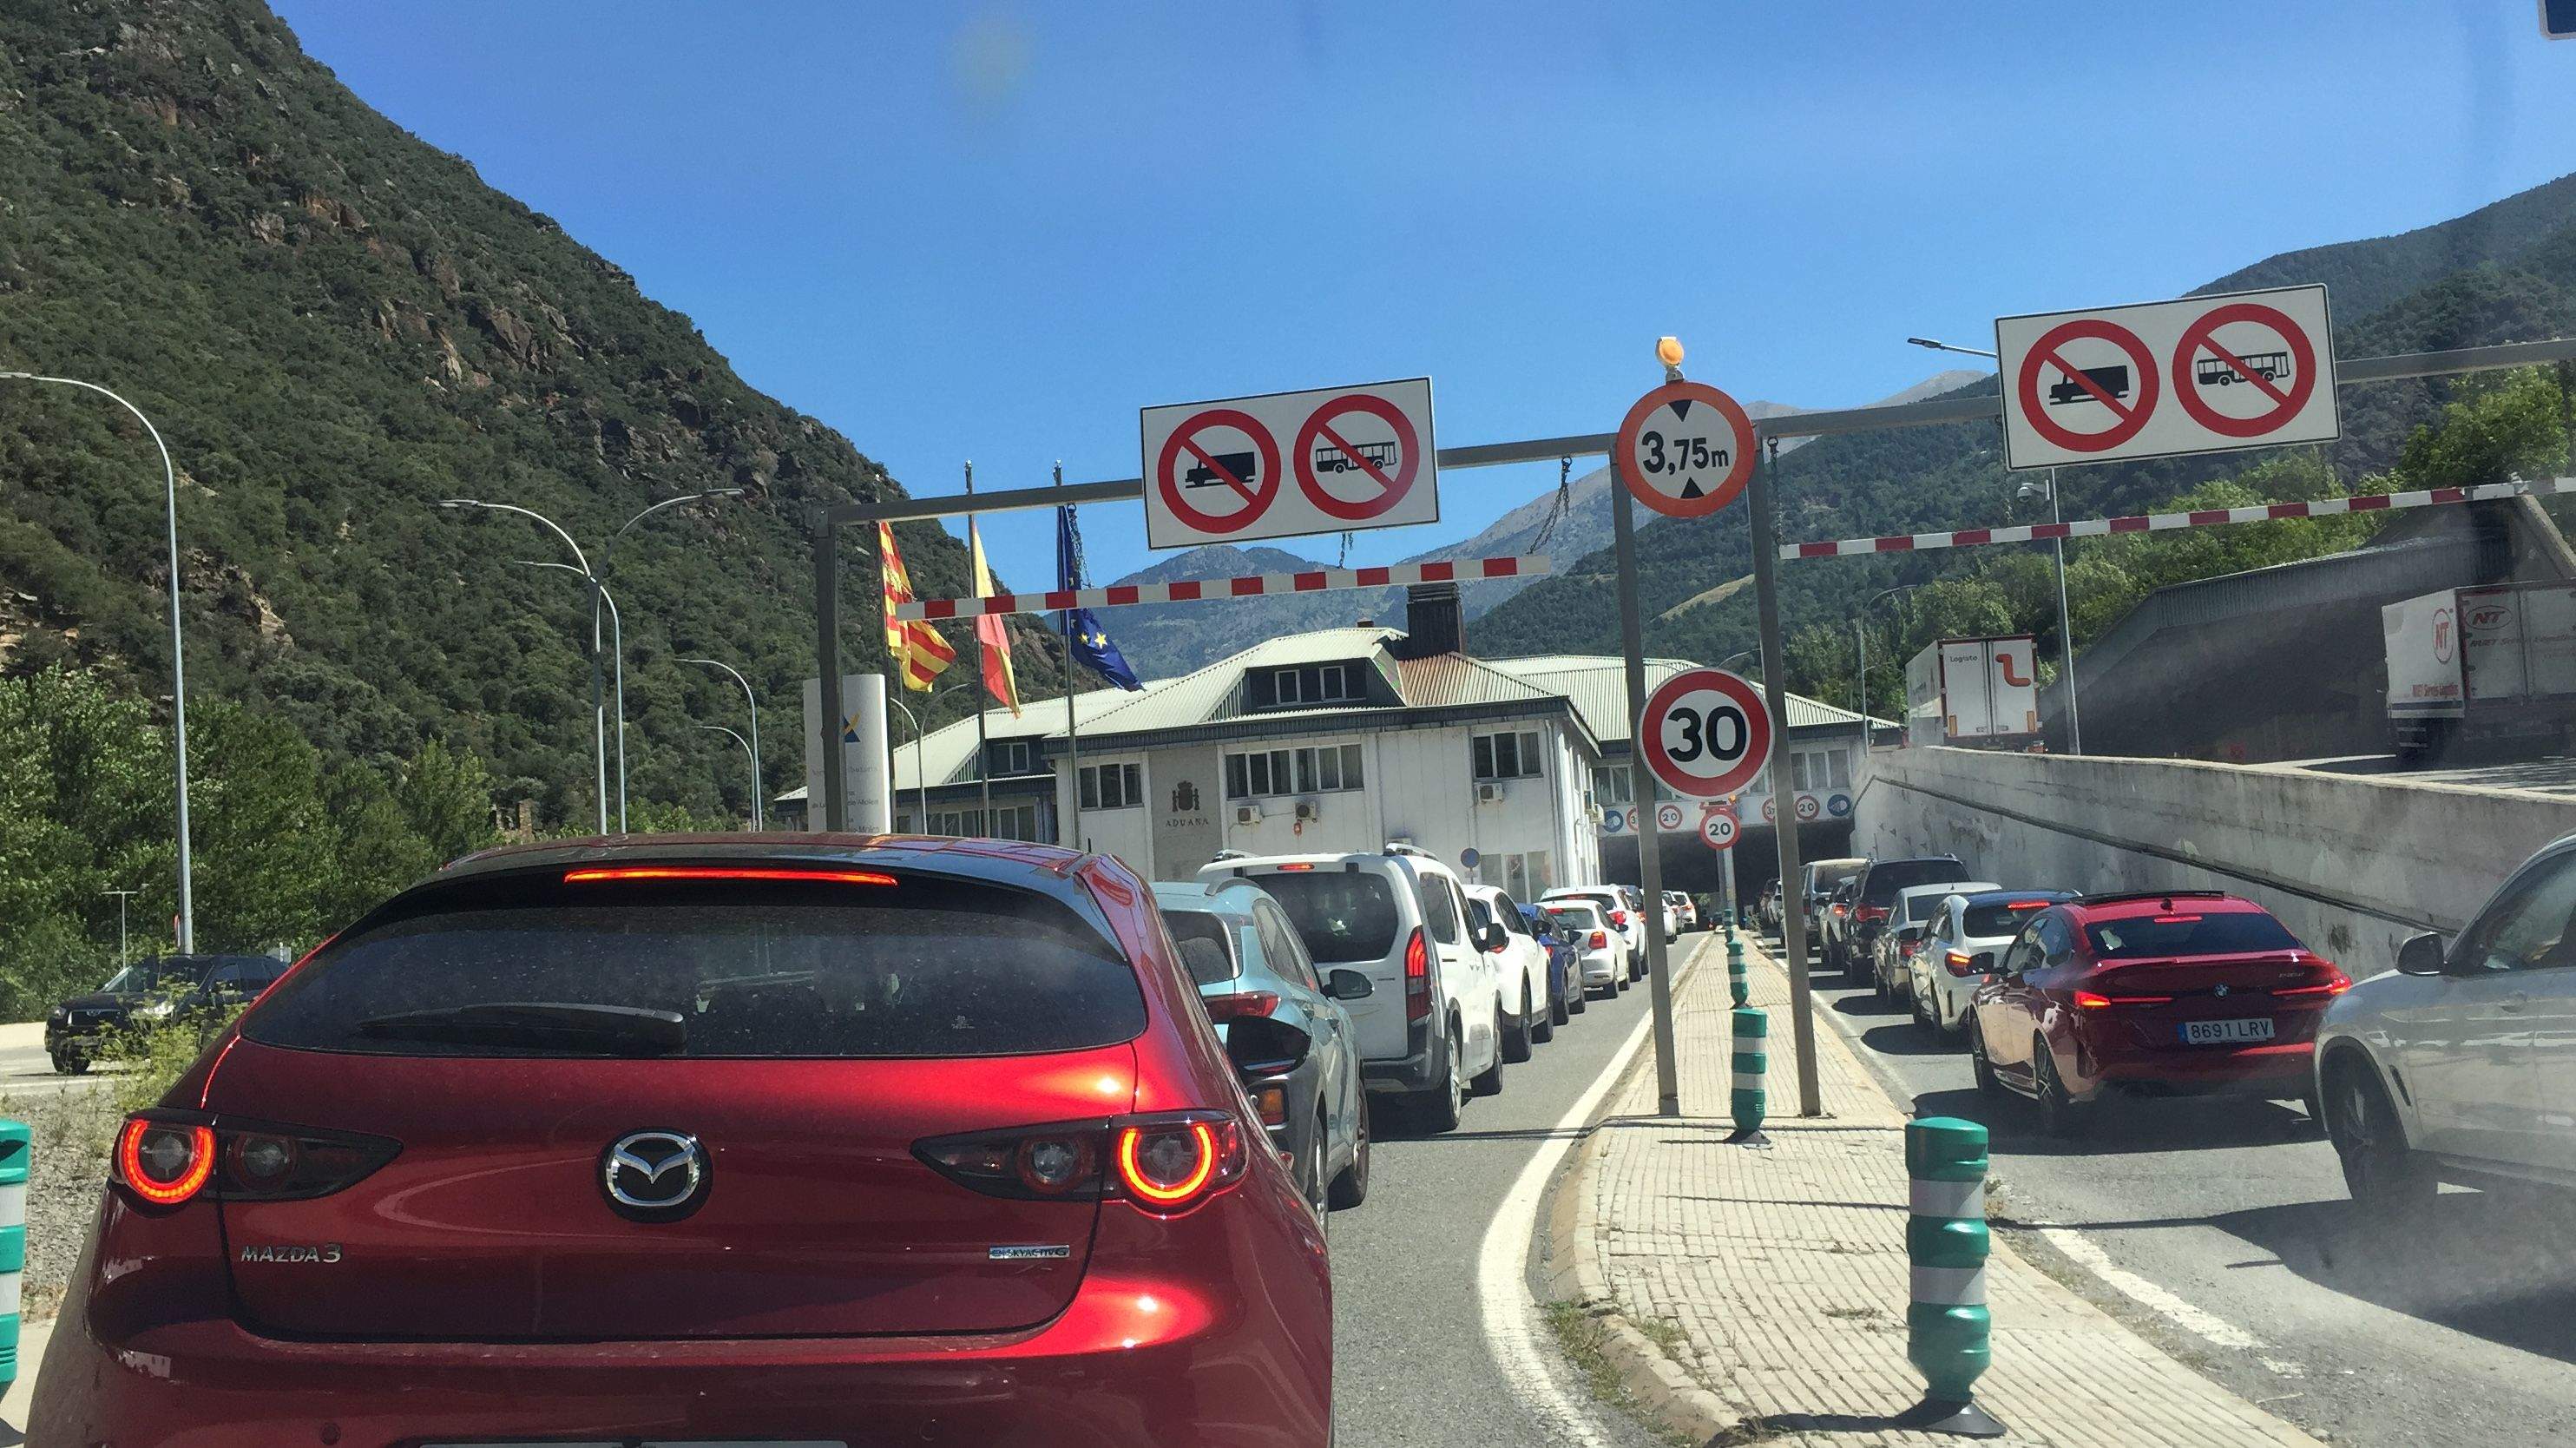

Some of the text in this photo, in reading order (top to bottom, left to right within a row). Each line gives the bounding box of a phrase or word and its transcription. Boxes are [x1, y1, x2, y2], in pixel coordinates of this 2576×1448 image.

[1641, 431, 1730, 475] 3,75m
[1666, 705, 1747, 763] 30
[1798, 802, 1815, 813] 20
[1165, 818, 1209, 827] ADUANA
[1661, 813, 1678, 822] 20
[1708, 822, 1732, 836] 20
[2191, 1021, 2269, 1039] 8691 LRV
